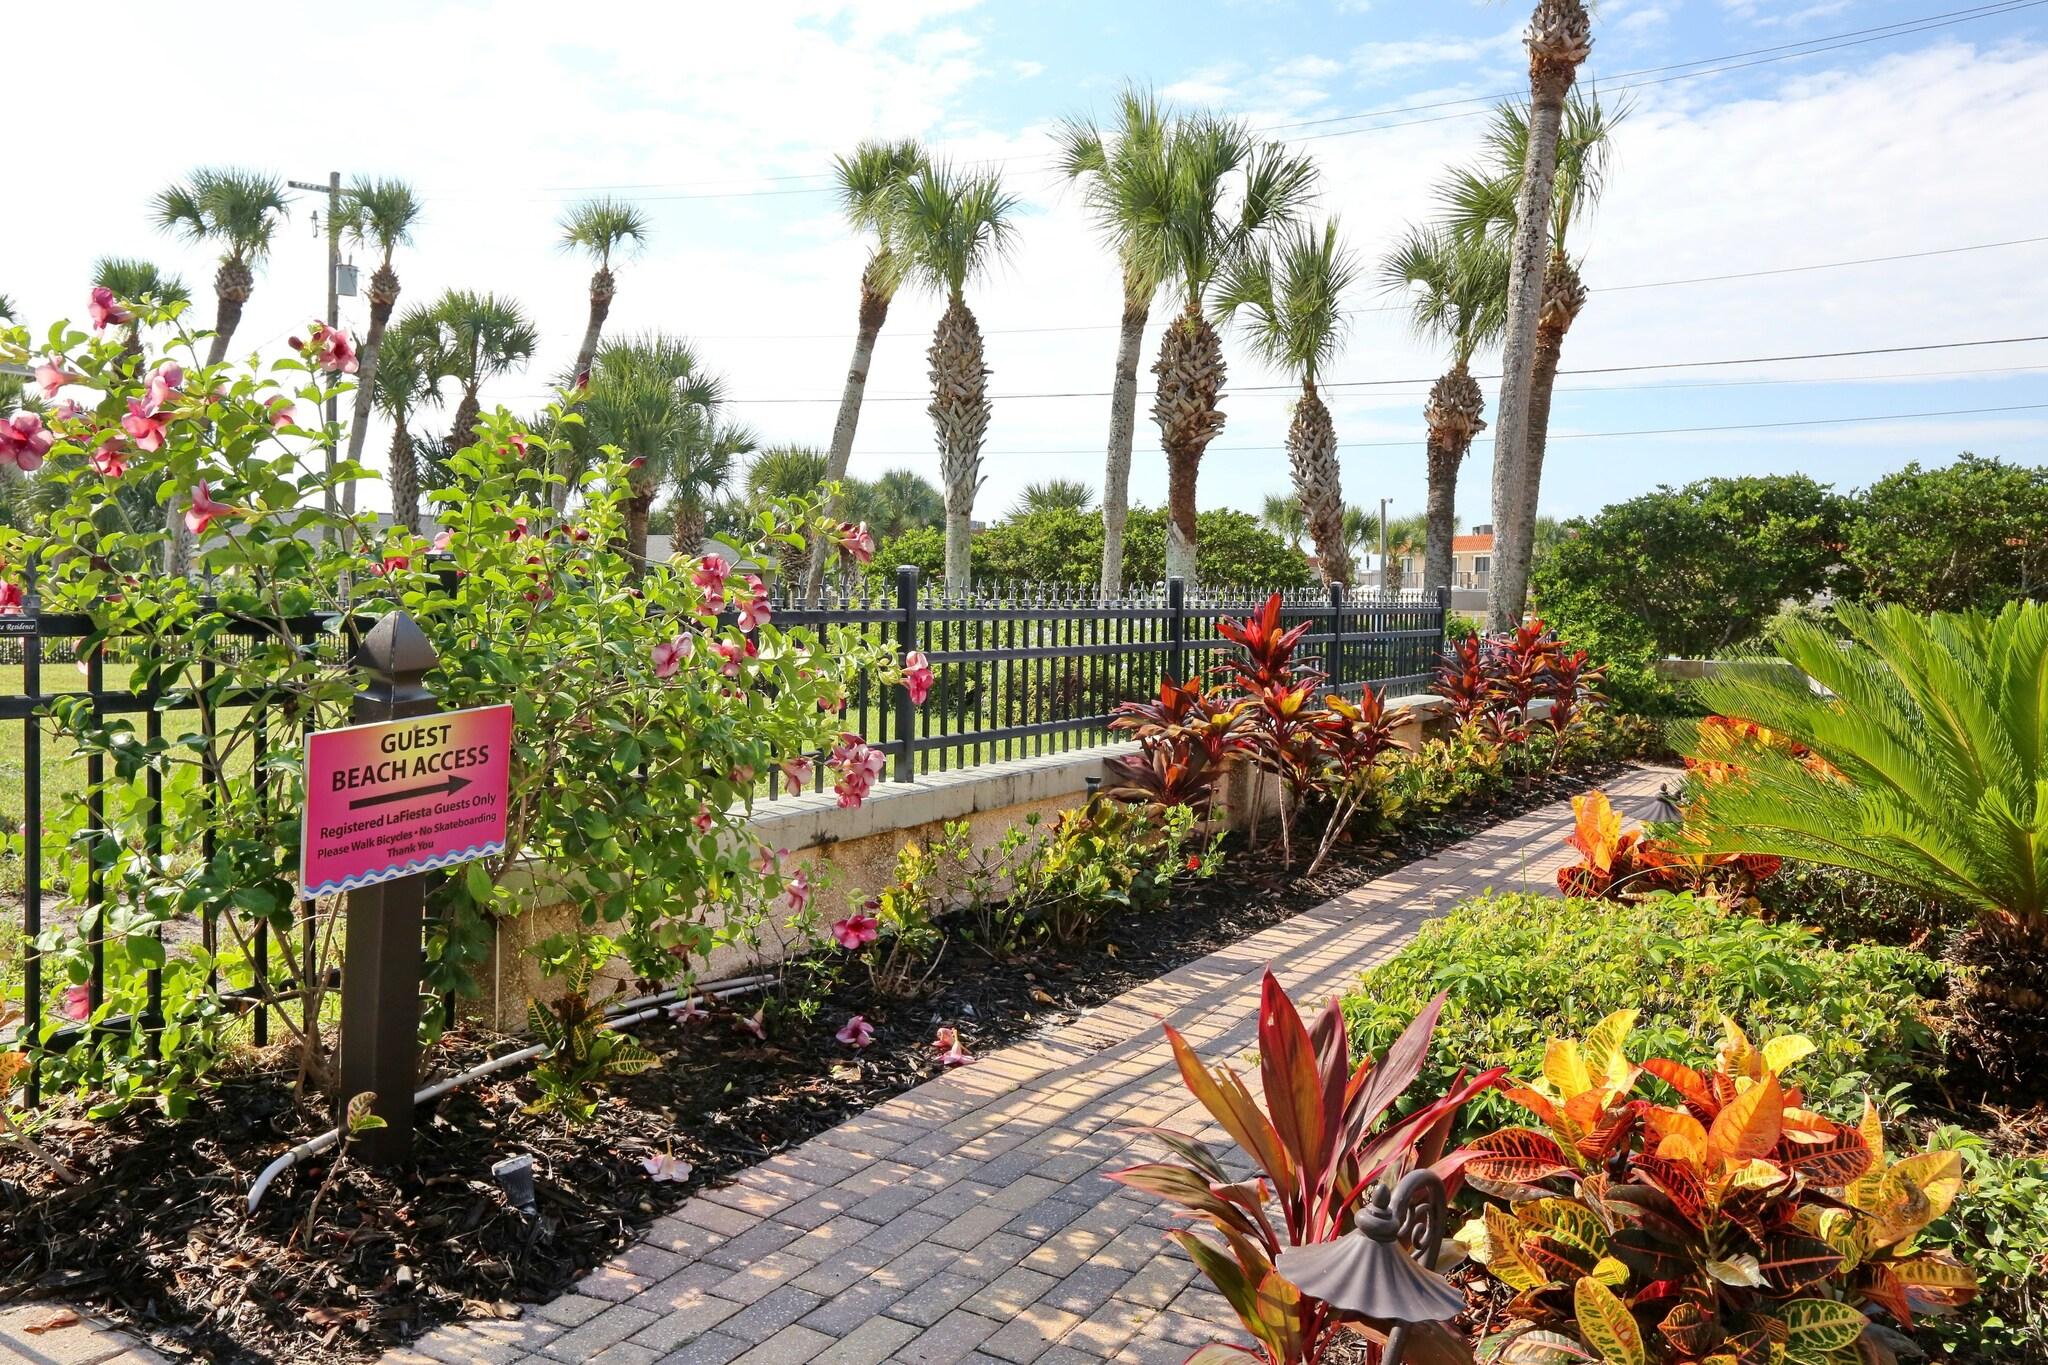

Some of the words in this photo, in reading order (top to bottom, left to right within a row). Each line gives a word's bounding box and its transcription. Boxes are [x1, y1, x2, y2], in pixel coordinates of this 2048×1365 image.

[6, 623, 35, 631] Residence
[381, 725, 452, 754] GUEST
[332, 759, 406, 792] BEACH
[412, 745, 489, 777] ACCESS
[320, 815, 384, 840] Registered
[386, 808, 432, 826] LaFiesta
[434, 799, 470, 815] Guests
[472, 793, 497, 807] Only
[317, 846, 349, 860] Please
[351, 839, 375, 852] Walk
[376, 830, 414, 846] Bicycles
[419, 826, 433, 837] No
[434, 812, 497, 834] Skateboarding
[386, 845, 417, 858] Thank
[418, 840, 434, 851] You
